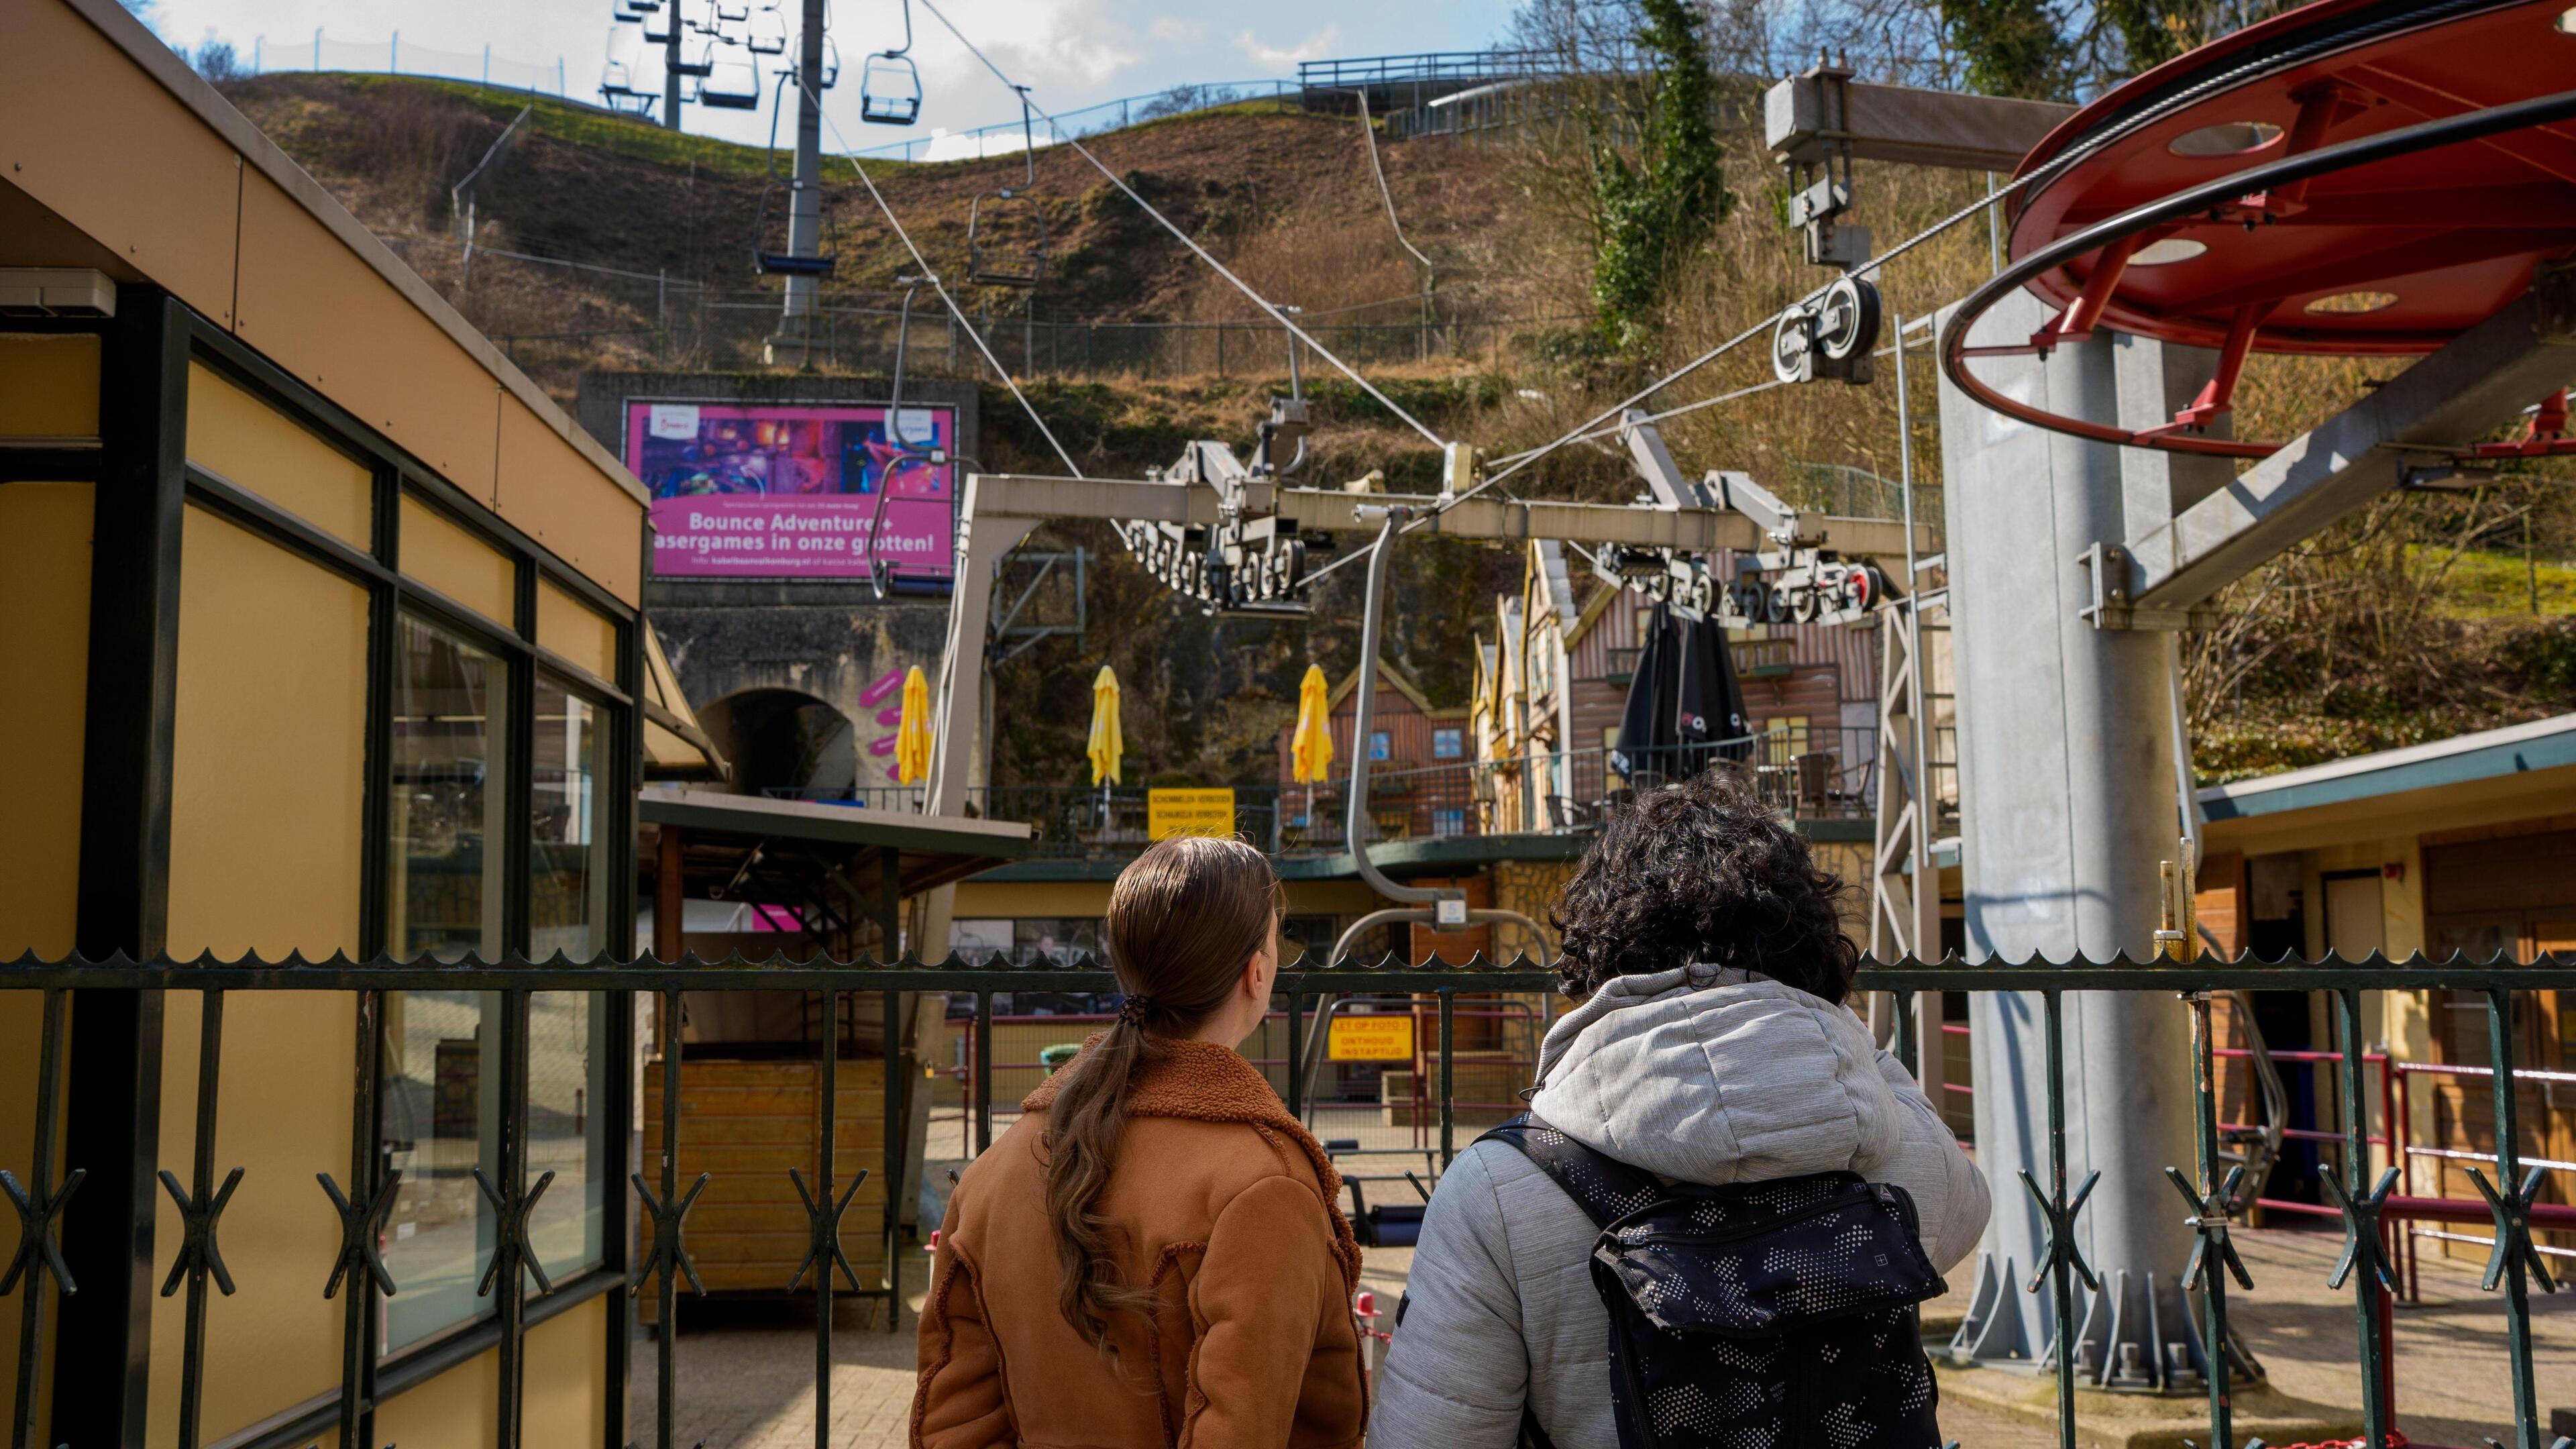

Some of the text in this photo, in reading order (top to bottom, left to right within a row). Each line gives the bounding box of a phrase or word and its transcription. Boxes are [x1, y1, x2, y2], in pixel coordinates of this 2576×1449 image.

[689, 512, 893, 532] Bounce Adventure +
[654, 534, 765, 554] asergames
[772, 533, 790, 550] in
[798, 537, 845, 551] onze
[1333, 1020, 1351, 1031] LET
[1354, 1020, 1369, 1031] OP
[1371, 1020, 1399, 1031] FOTO
[1341, 1036, 1394, 1045] ONTHOUD
